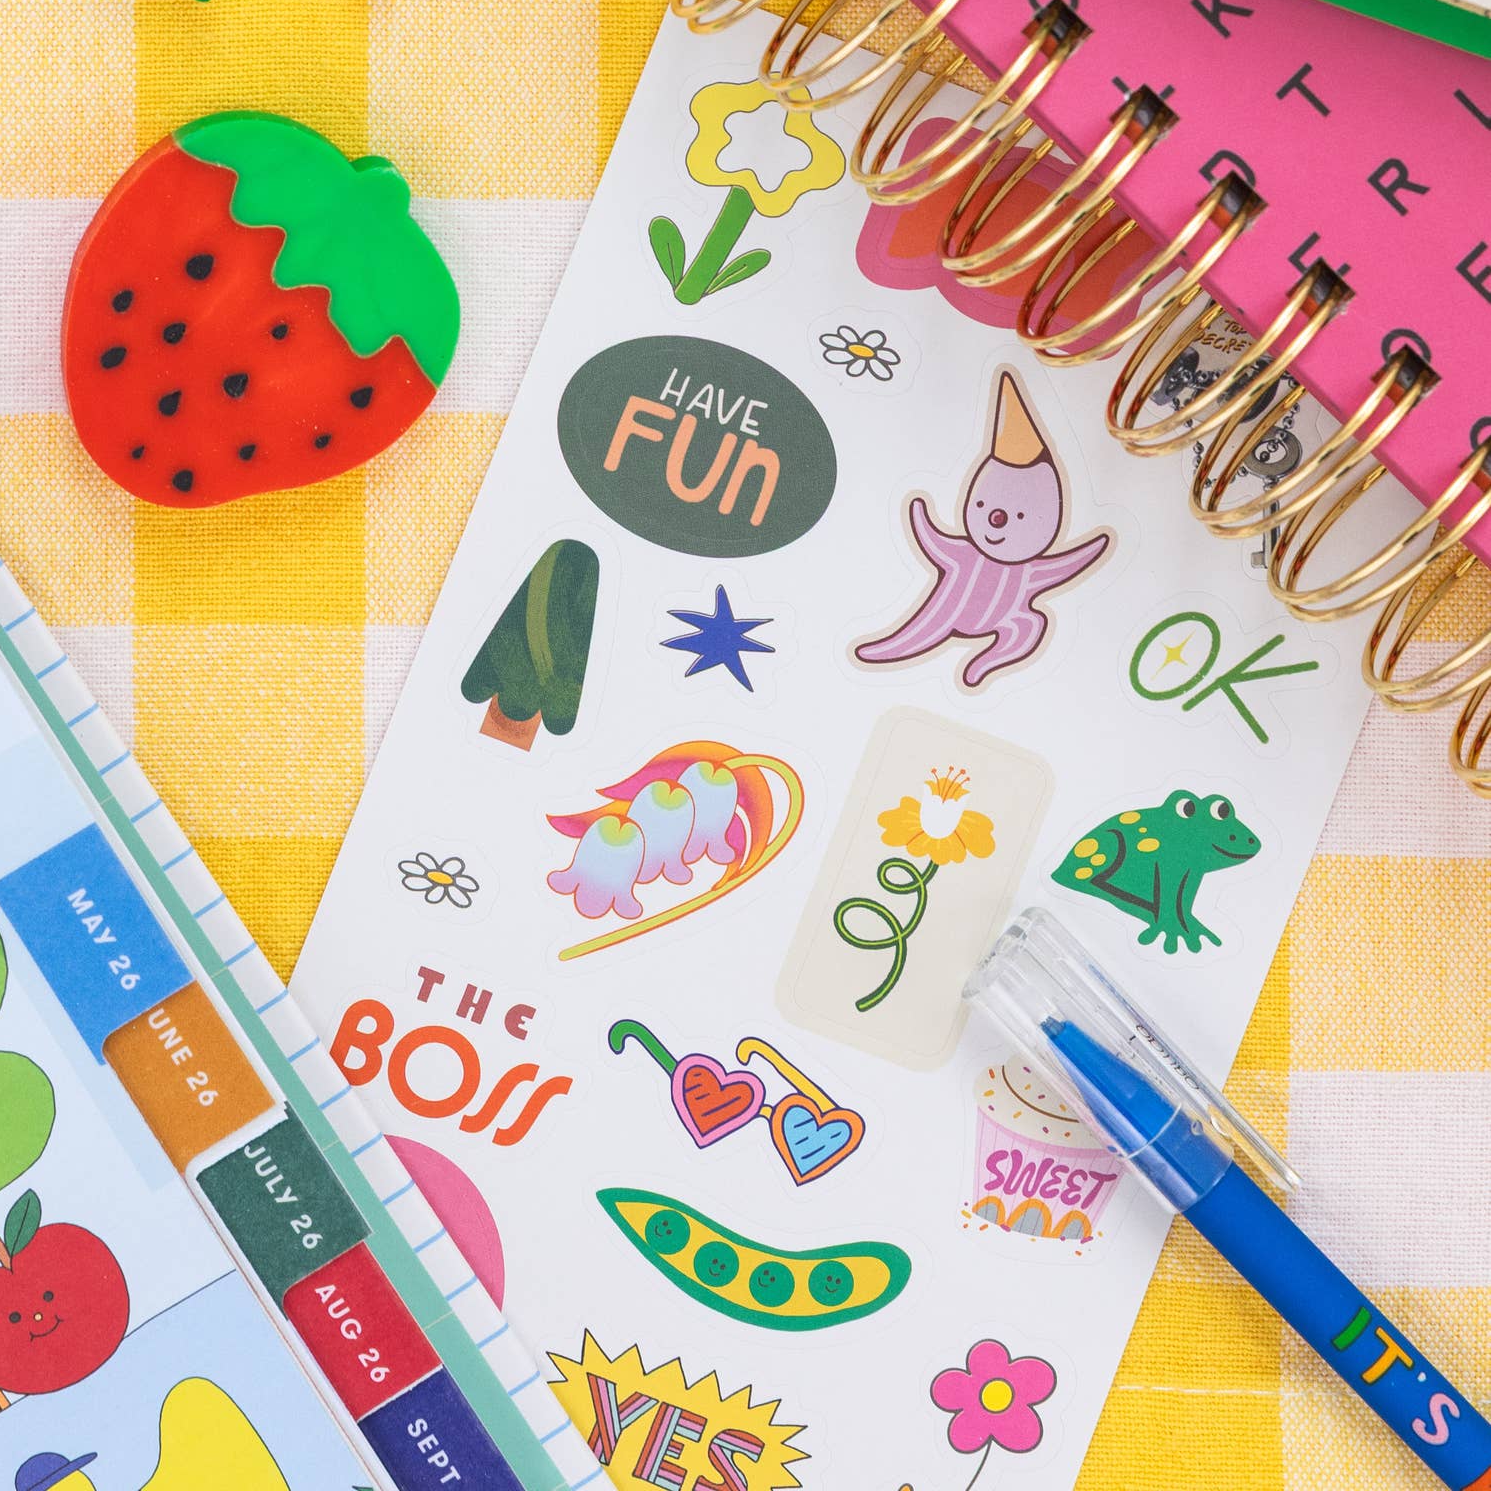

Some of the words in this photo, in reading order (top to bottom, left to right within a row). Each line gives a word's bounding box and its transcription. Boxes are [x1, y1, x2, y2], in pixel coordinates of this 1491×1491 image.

[660, 367, 769, 437] HAVE
[1129, 612, 1319, 744] OK
[67, 887, 117, 945] MAY
[108, 954, 141, 991] 26
[417, 965, 537, 1041] THE
[148, 1007, 194, 1067] UNE
[185, 1070, 219, 1108] 26
[329, 999, 574, 1147] BOSS
[243, 1144, 298, 1204] JULY
[290, 1213, 323, 1249] 26
[984, 1149, 1118, 1210] SWEET
[314, 1283, 363, 1341] AUG
[357, 1347, 391, 1383] 26
[1330, 1305, 1462, 1446] IT'S
[407, 1417, 462, 1485] SEPT
[586, 1372, 766, 1491] YES
